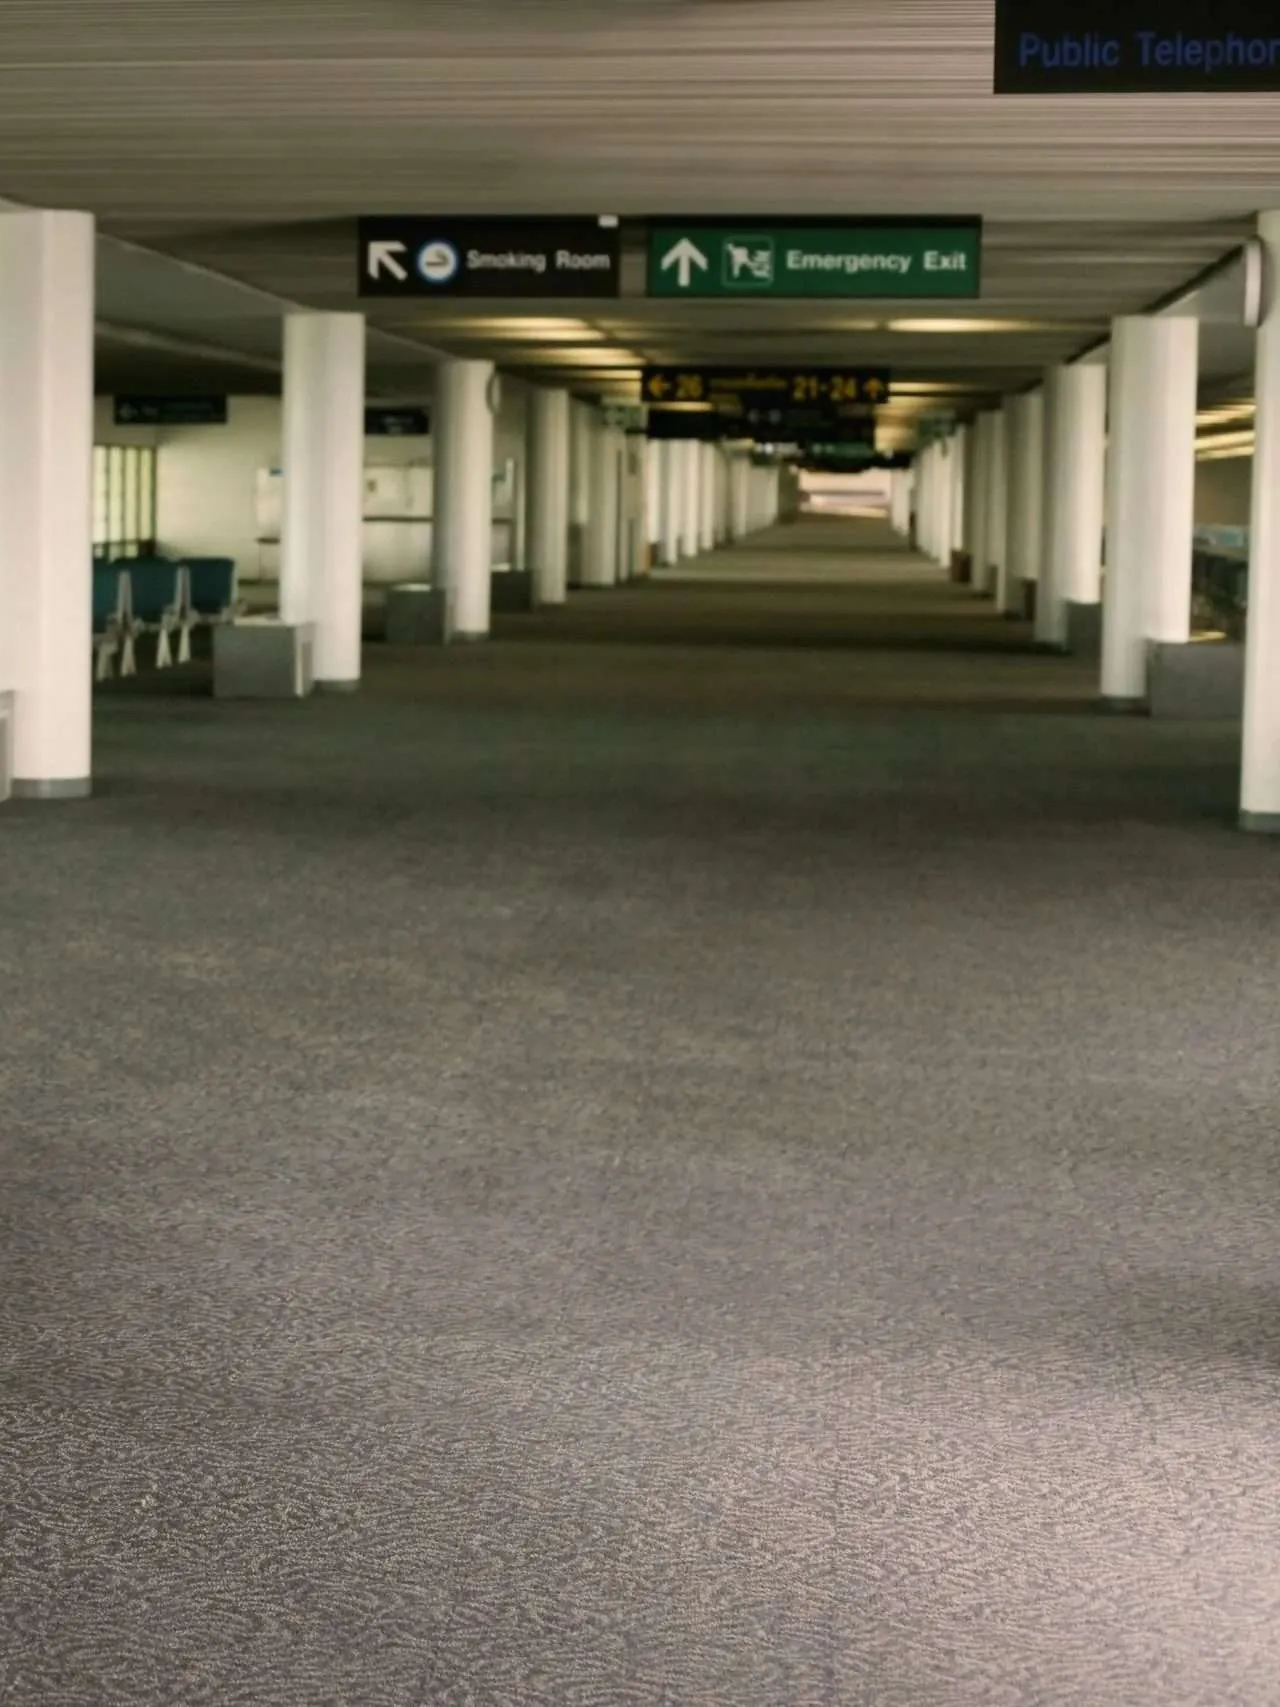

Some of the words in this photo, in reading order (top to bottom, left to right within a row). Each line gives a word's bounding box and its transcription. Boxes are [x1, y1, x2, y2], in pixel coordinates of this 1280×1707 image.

[1019, 31, 1120, 68] Public
[466, 249, 547, 274] Smoking
[554, 249, 611, 270] Room
[786, 249, 912, 275] Emergency
[923, 249, 968, 271] Exit
